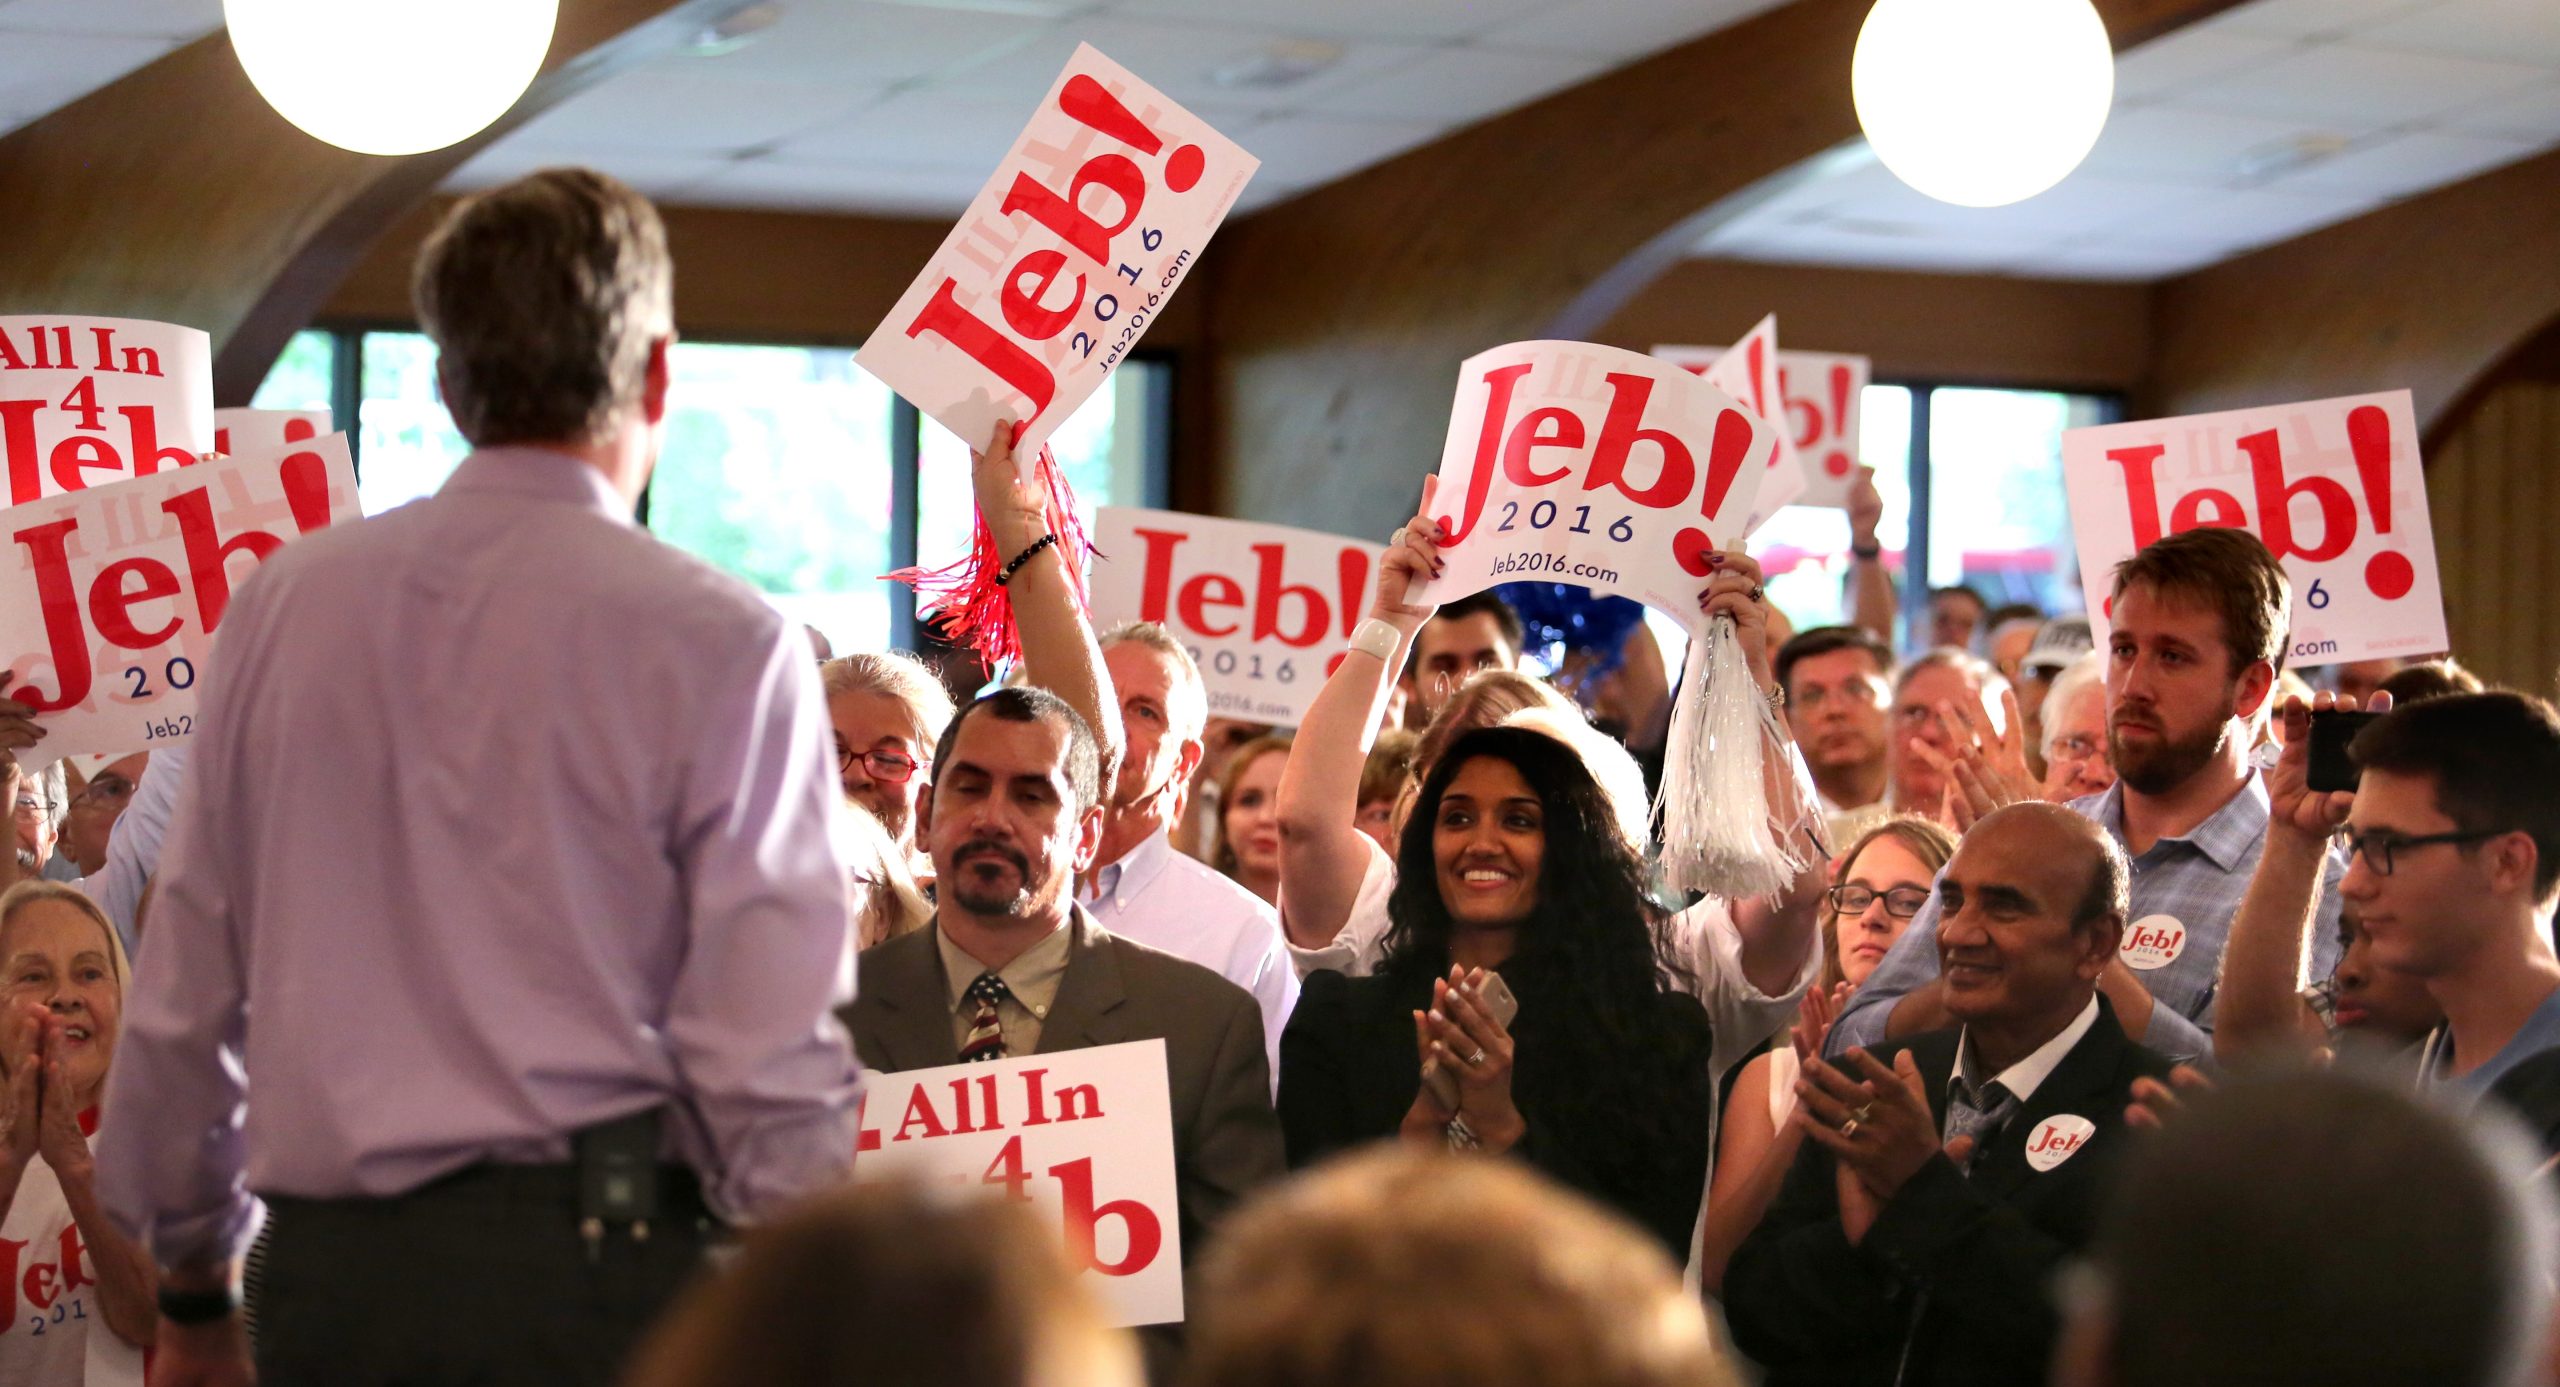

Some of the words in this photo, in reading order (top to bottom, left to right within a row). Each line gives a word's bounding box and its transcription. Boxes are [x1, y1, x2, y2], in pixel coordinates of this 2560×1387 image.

[905, 74, 1206, 449] Jeb!
[1071, 226, 1164, 359] 2016
[1099, 248, 1192, 374] Jeb2016.com
[89, 327, 165, 377] In
[60, 376, 107, 431] 4
[1436, 363, 1753, 577] Jeb!
[1497, 500, 1634, 543] 2016
[1490, 552, 1619, 584] Jeb2016.com
[124, 657, 195, 699] 20
[2121, 926, 2182, 958] Jeb!
[893, 1074, 1005, 1142] All
[1019, 1068, 1105, 1127] In
[982, 1135, 1033, 1202] 4
